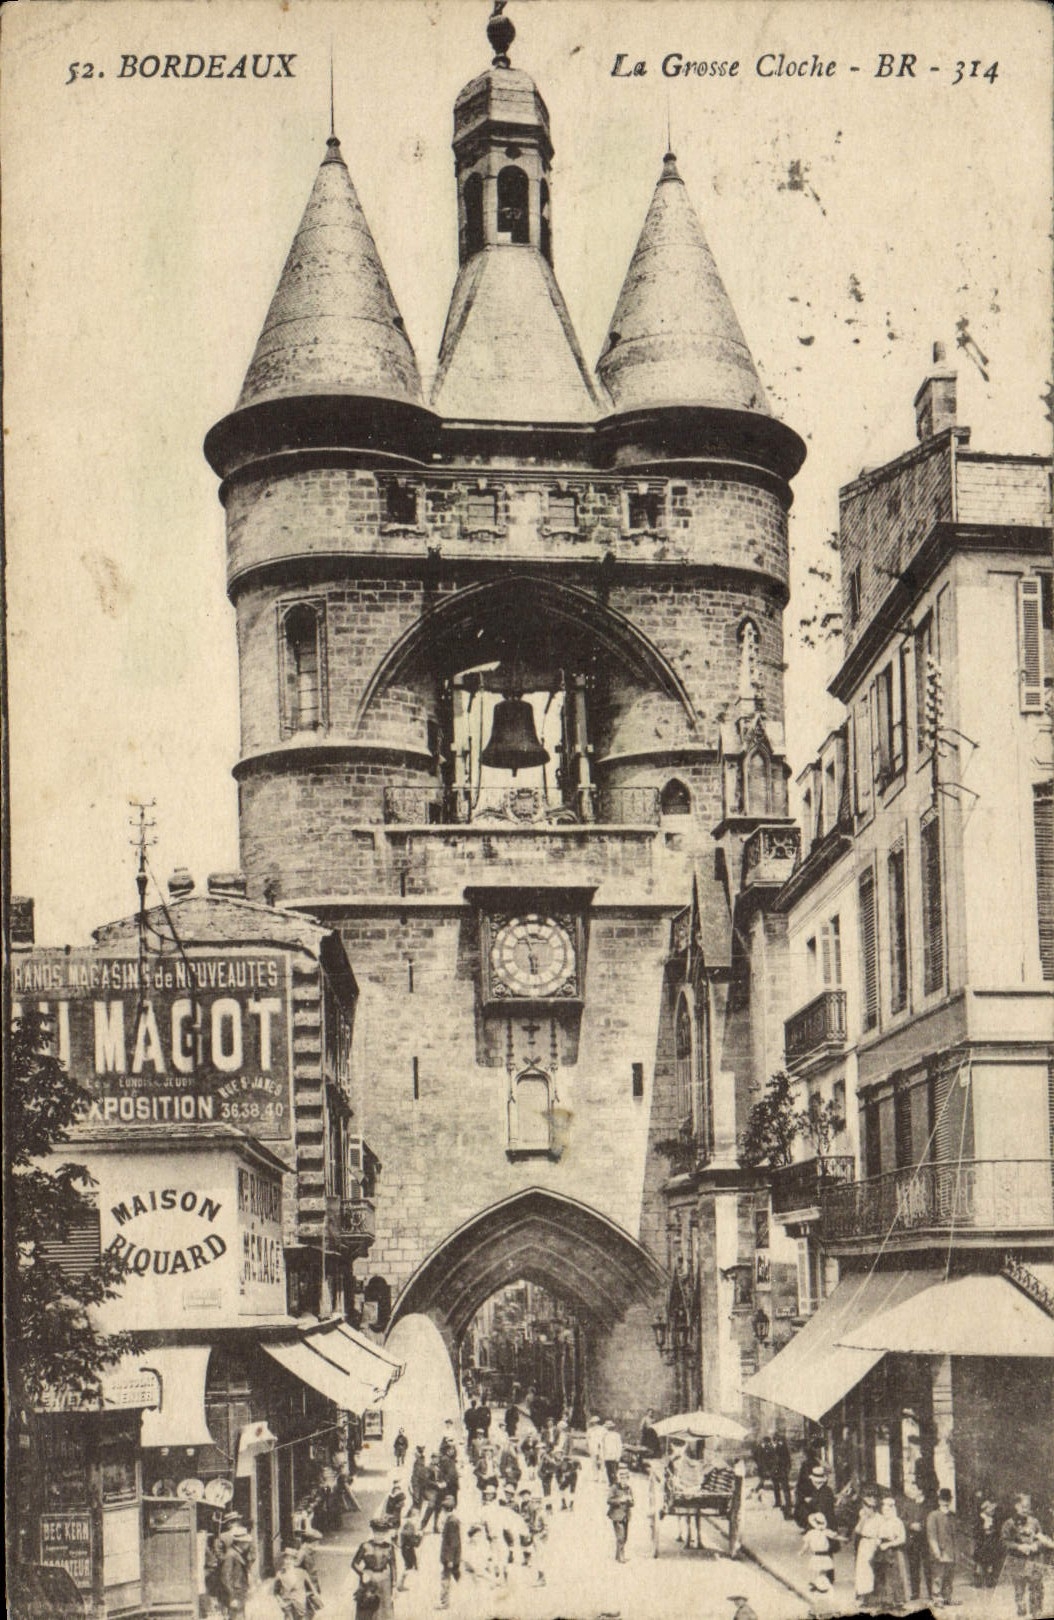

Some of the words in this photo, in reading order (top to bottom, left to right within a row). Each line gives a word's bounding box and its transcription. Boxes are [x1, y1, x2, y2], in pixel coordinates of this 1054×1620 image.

[13, 963, 63, 991] RANDS
[155, 966, 173, 989] de
[94, 998, 282, 1074] MAGOT
[217, 1079, 240, 1099] RUE
[86, 1096, 214, 1120] XPOSITION
[111, 1189, 222, 1226] MAISON
[108, 1233, 227, 1277] RIQUARD
[43, 1522, 62, 1540] BEC
